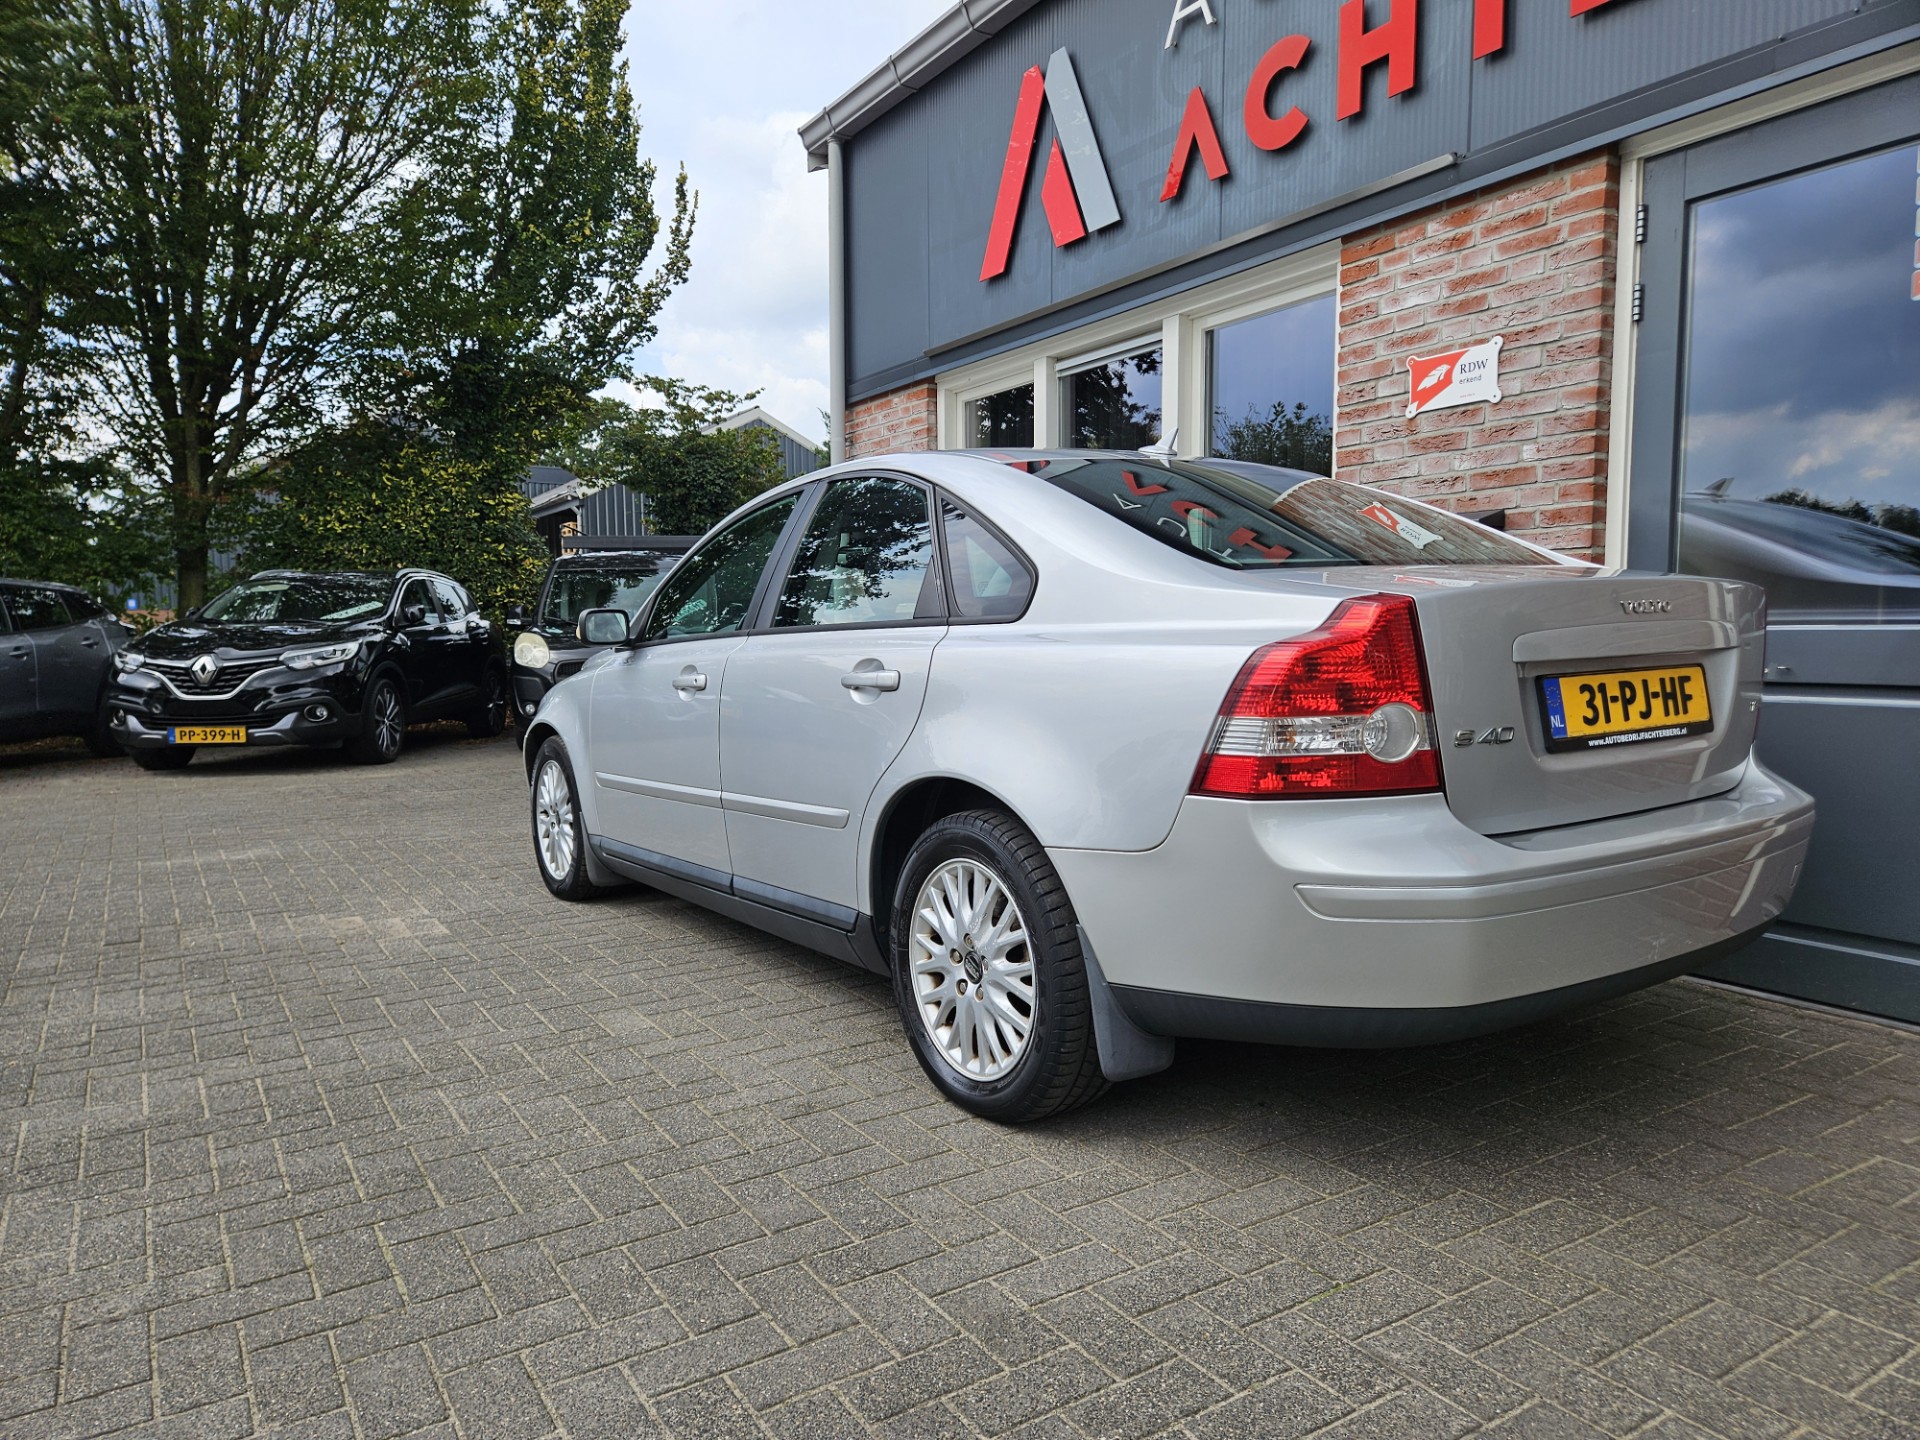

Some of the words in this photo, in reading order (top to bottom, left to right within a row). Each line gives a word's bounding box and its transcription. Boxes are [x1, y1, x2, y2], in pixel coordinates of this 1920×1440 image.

[1460, 360, 1488, 374] RDW
[1459, 374, 1482, 385] erkend
[1619, 599, 1671, 615] VOLVO
[1579, 675, 1693, 726] 31-PJ-HF
[1550, 714, 1565, 728] NL
[179, 729, 241, 741] PP-399-H
[1588, 726, 1688, 747] www.AUTOBEDRIJFACHTERBERG.nl
